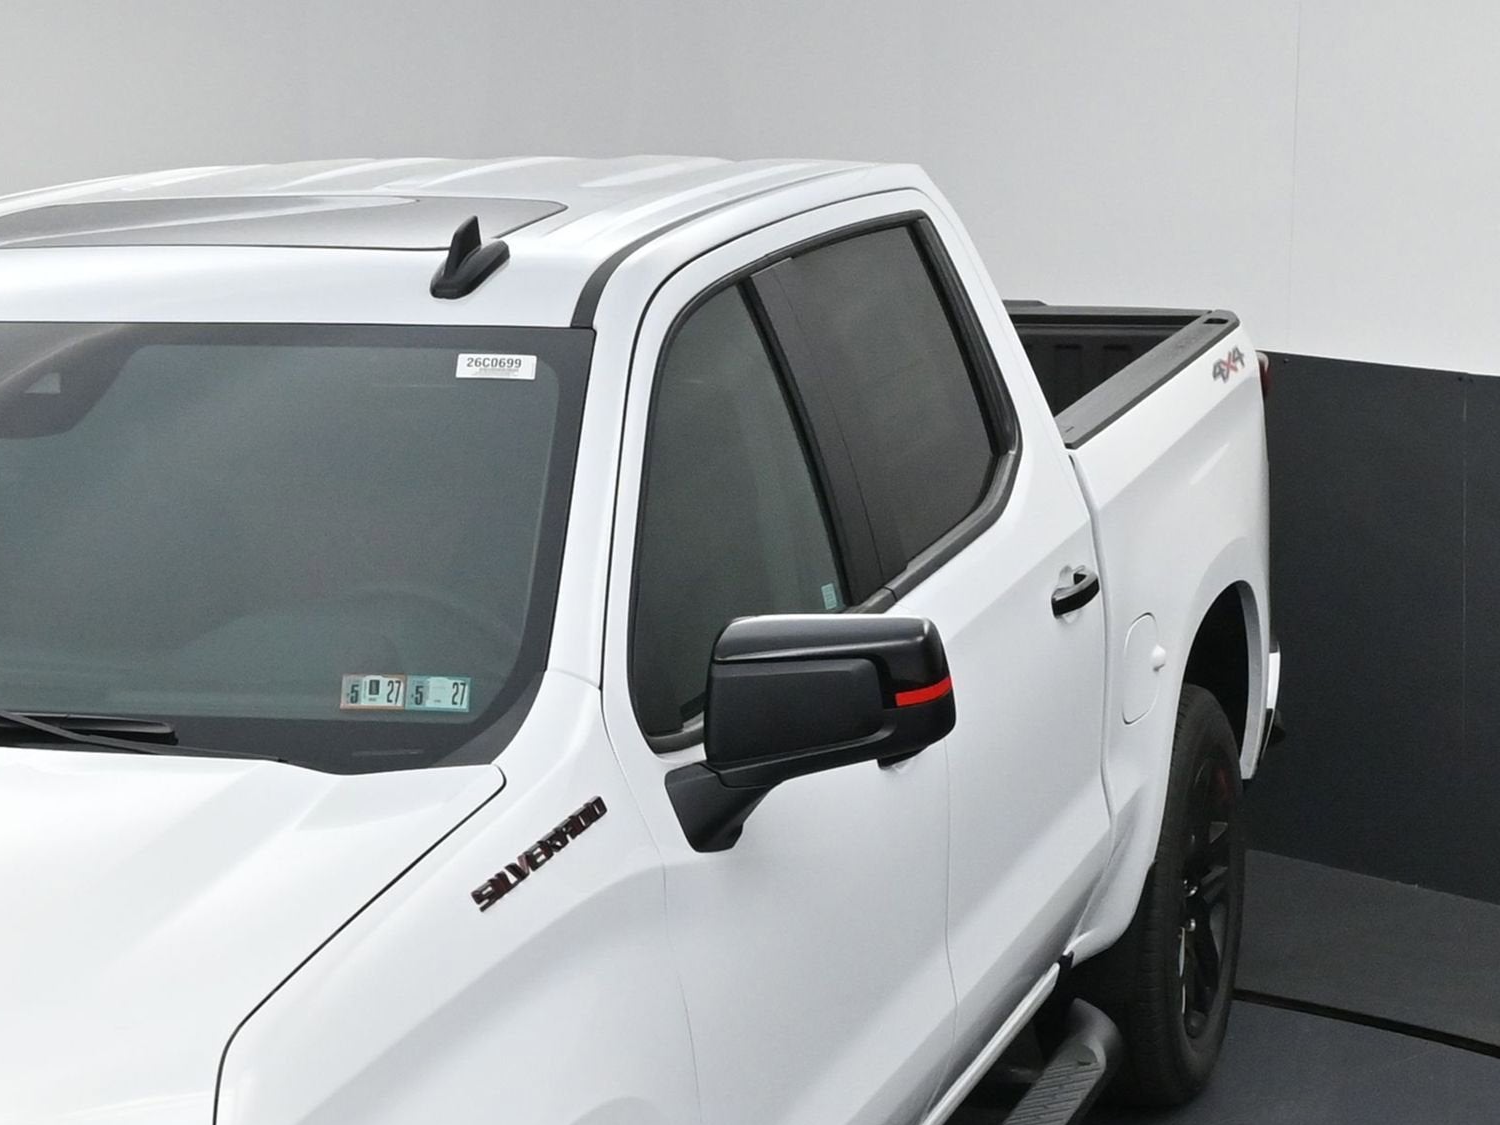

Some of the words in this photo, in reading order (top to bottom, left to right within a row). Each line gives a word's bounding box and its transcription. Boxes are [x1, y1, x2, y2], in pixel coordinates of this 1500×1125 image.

[466, 357, 522, 369] 26C0699
[350, 683, 359, 704] 5
[387, 680, 402, 704] 27
[414, 685, 424, 706] 5
[451, 682, 467, 706] 27
[470, 795, 608, 913] SILVERADO
